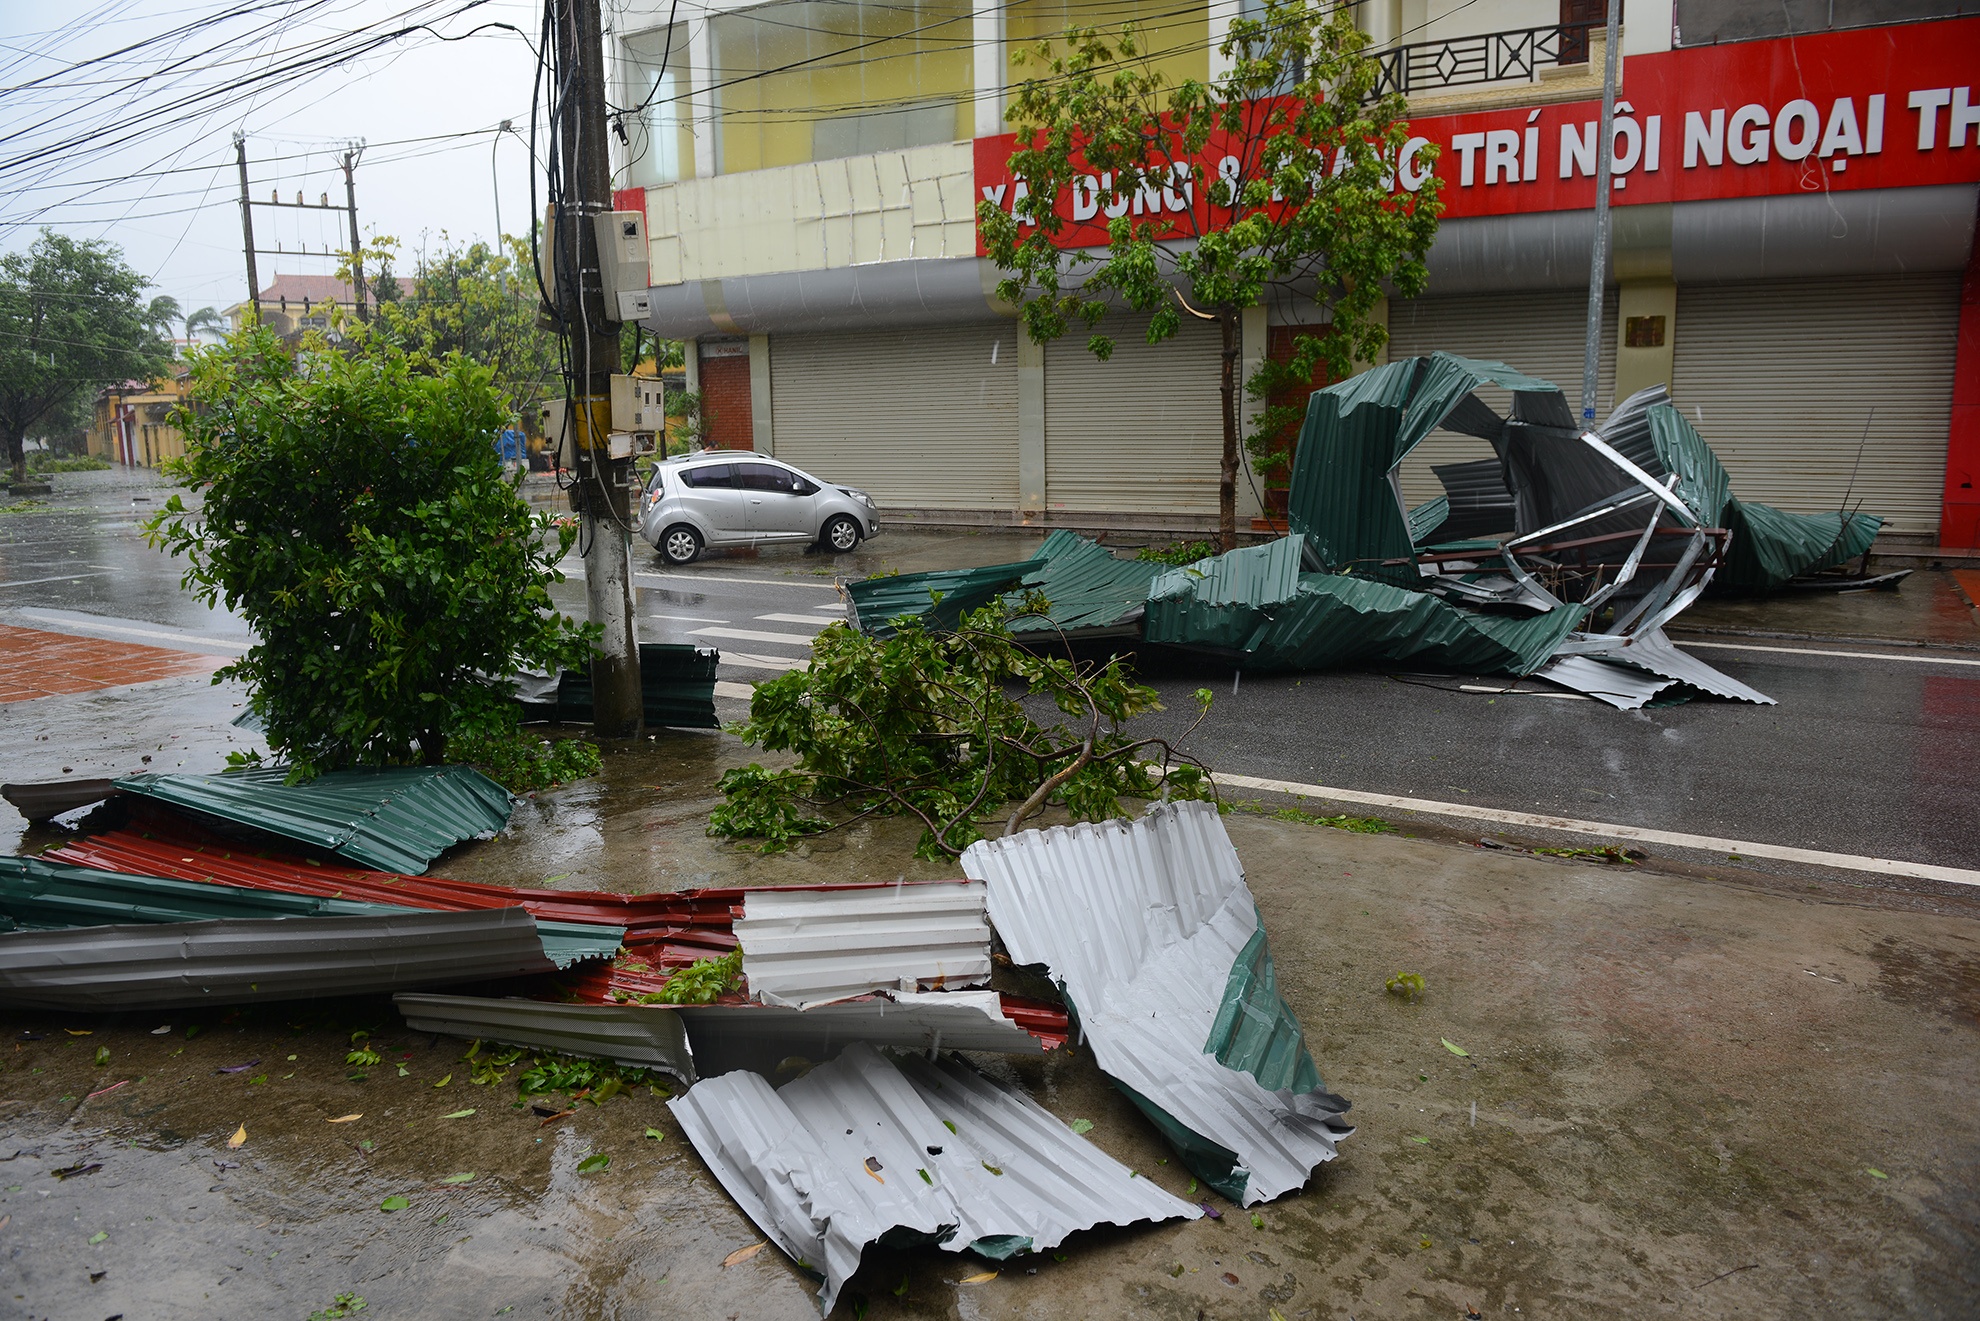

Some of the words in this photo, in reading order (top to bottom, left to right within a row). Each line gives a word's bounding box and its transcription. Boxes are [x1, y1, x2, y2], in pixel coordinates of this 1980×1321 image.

[1452, 108, 1542, 186] TRÍ
[1559, 101, 1661, 189] NỘI
[1683, 93, 1886, 172] NGOẠI
